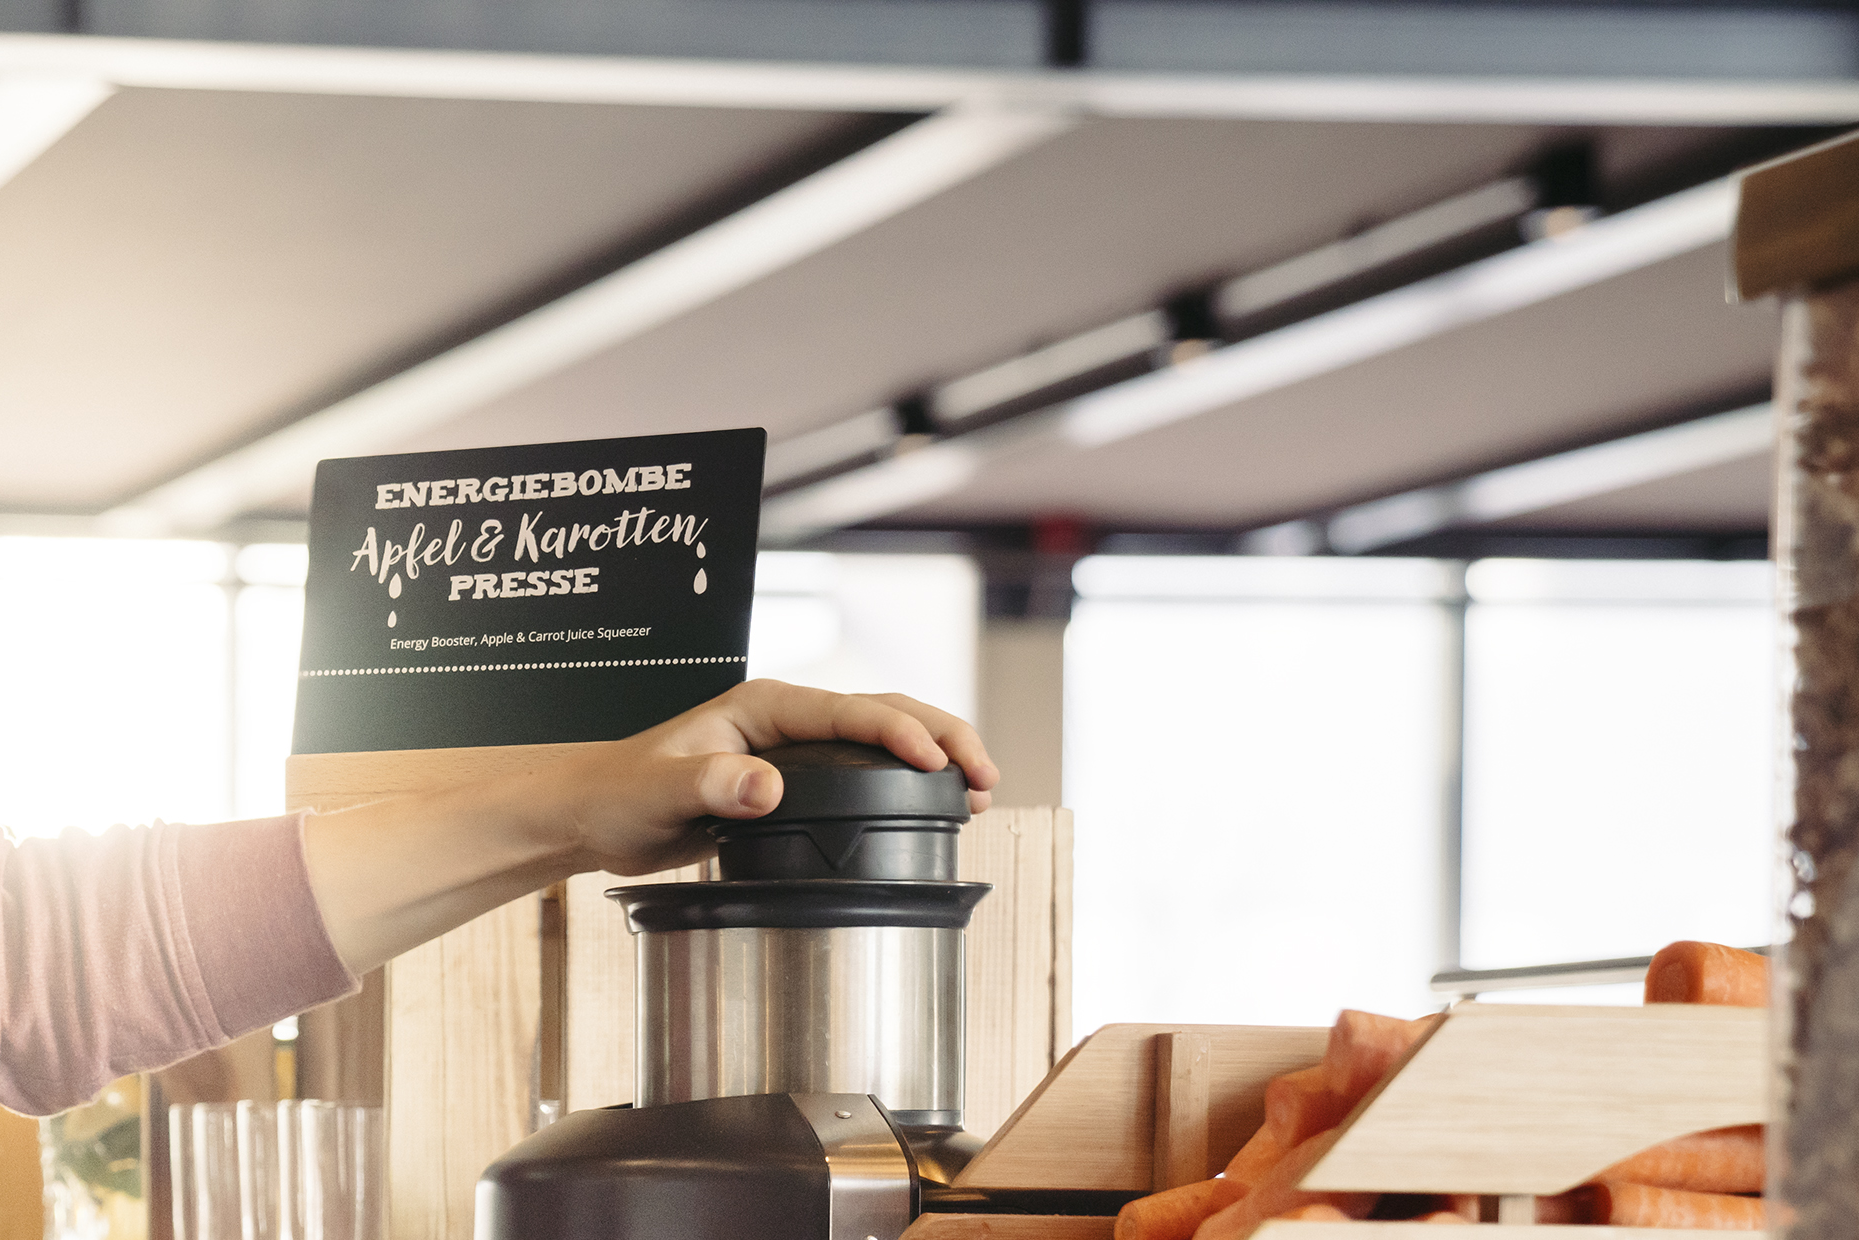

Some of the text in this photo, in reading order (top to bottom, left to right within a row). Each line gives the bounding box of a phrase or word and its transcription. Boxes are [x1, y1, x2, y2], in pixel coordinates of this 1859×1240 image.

[375, 462, 692, 510] ENERGIEBOMBE
[350, 506, 709, 584] Apfel & Karotten
[448, 567, 600, 601] PRESSE
[390, 626, 652, 651] Energy Booster, Apple & Carrot Juice Squeezer
